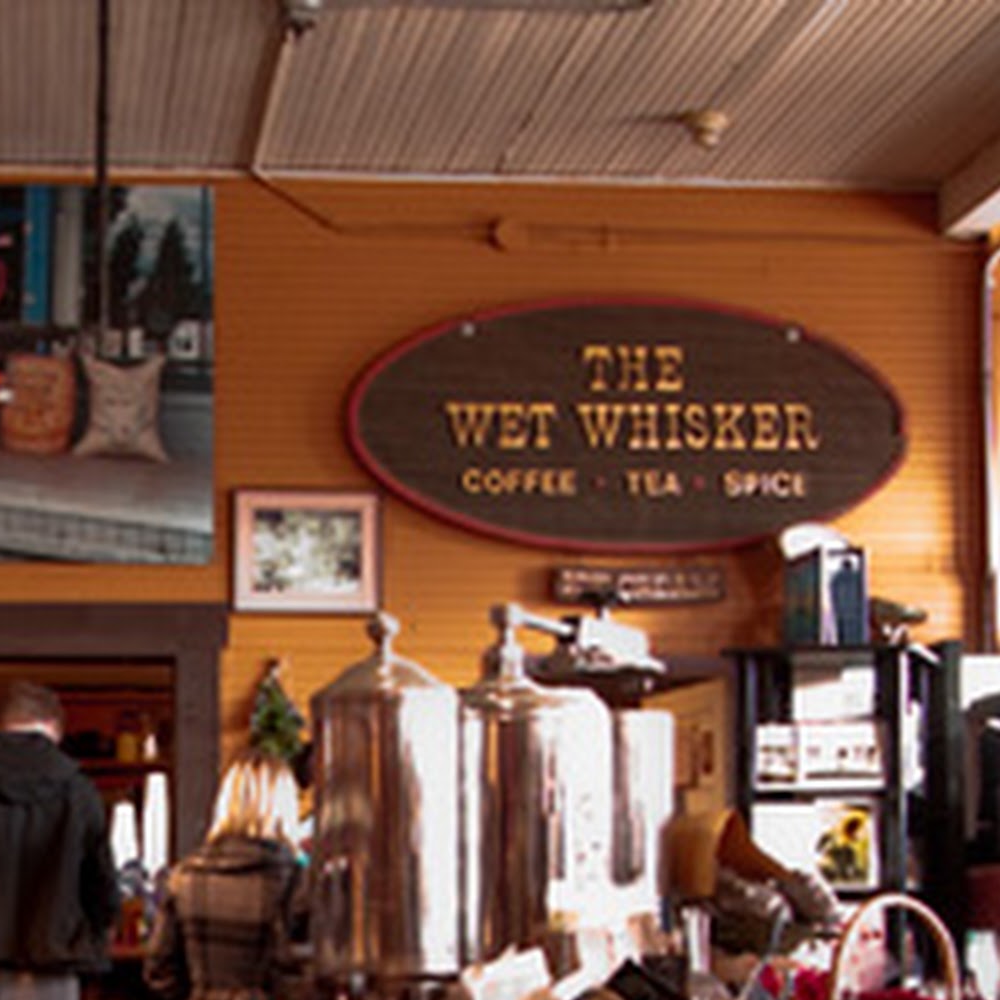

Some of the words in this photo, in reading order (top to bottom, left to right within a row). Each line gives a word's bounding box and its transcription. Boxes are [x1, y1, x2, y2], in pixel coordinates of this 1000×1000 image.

[582, 344, 684, 392] THE
[445, 402, 556, 450] WET
[576, 402, 820, 451] WHISKER
[461, 468, 577, 496] COFFEE
[627, 469, 682, 497] TEA
[722, 470, 807, 498] SPICE
